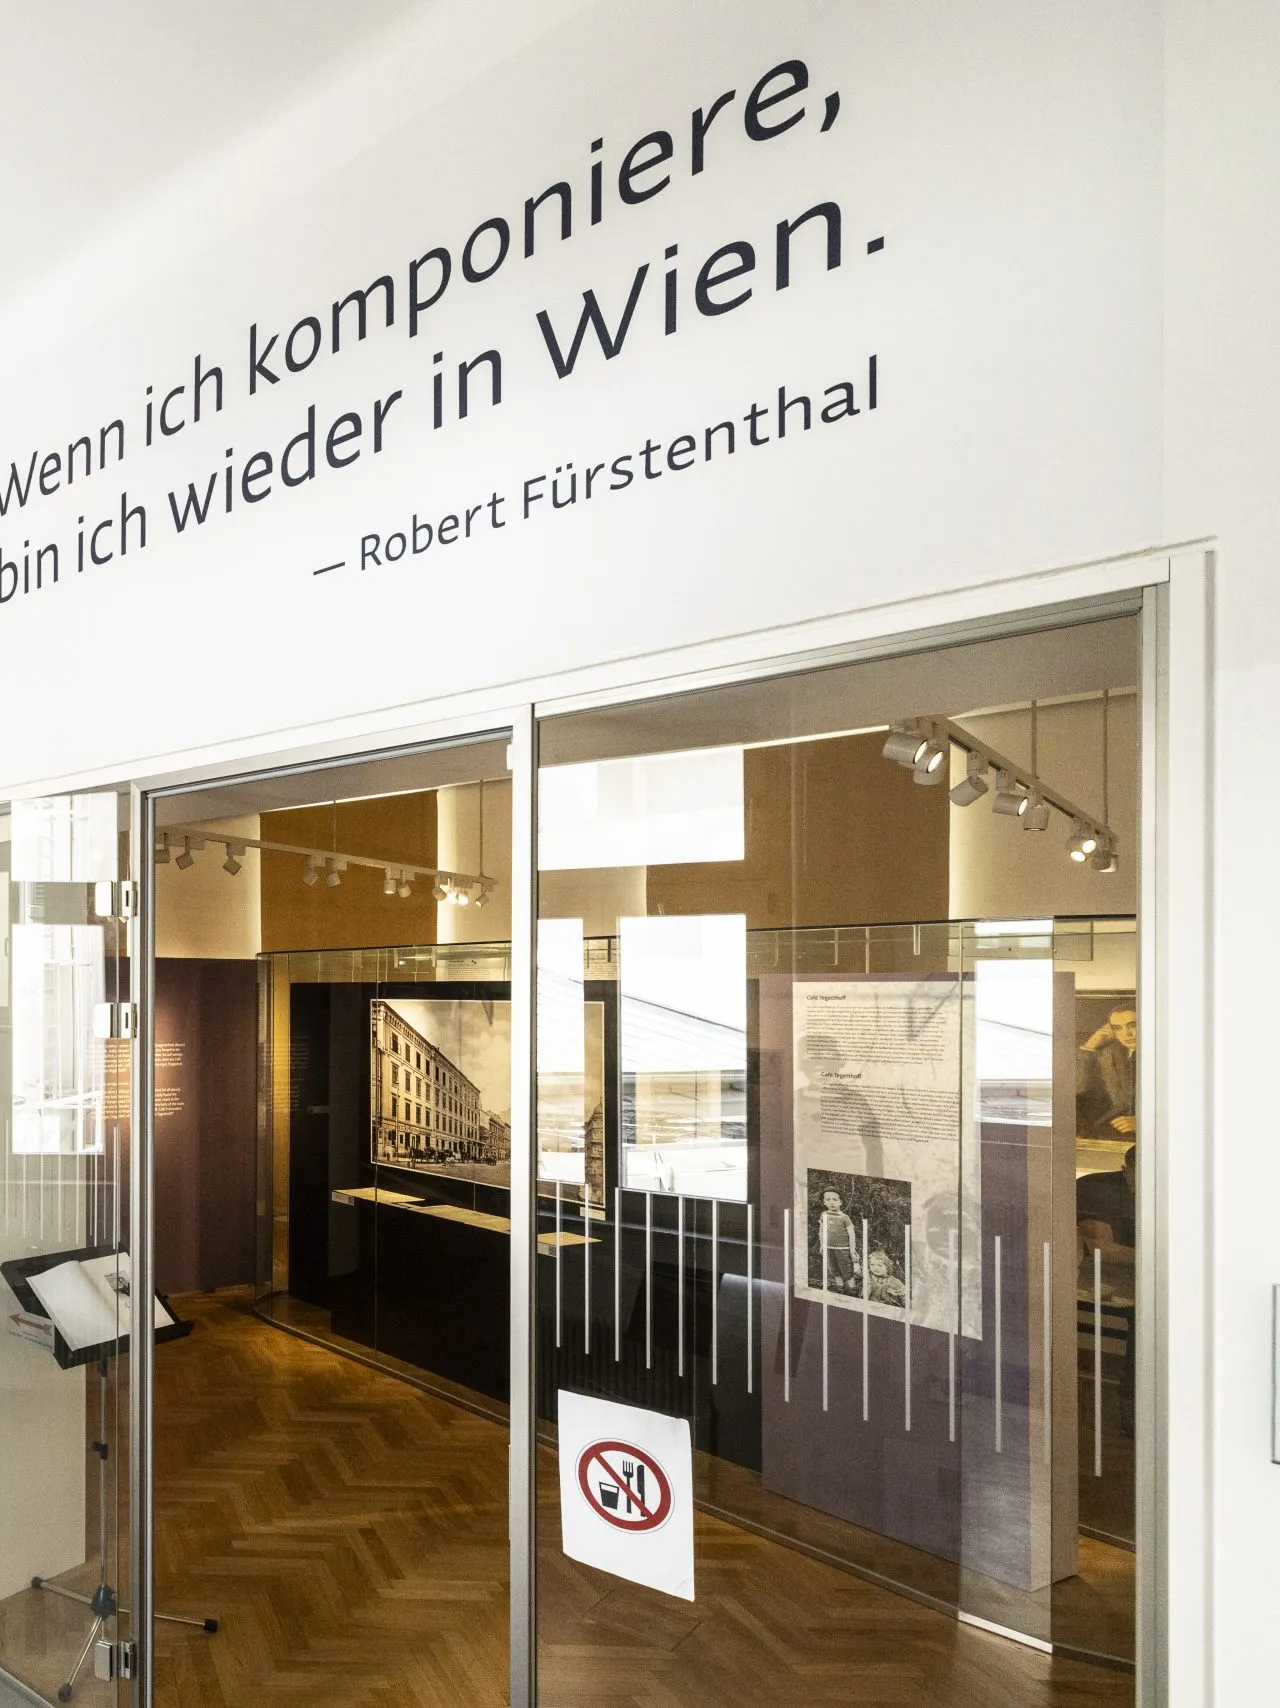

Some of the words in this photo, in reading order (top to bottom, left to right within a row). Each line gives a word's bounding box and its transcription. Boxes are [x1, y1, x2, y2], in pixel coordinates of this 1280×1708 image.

[77, 492, 146, 573] ich
[167, 389, 403, 534] wieder
[433, 350, 502, 430] in
[535, 202, 885, 380] Wien.
[146, 355, 223, 447] ich
[249, 59, 841, 396] komponiere,
[361, 492, 506, 571] Robert
[523, 354, 877, 520] Fürstenthal
